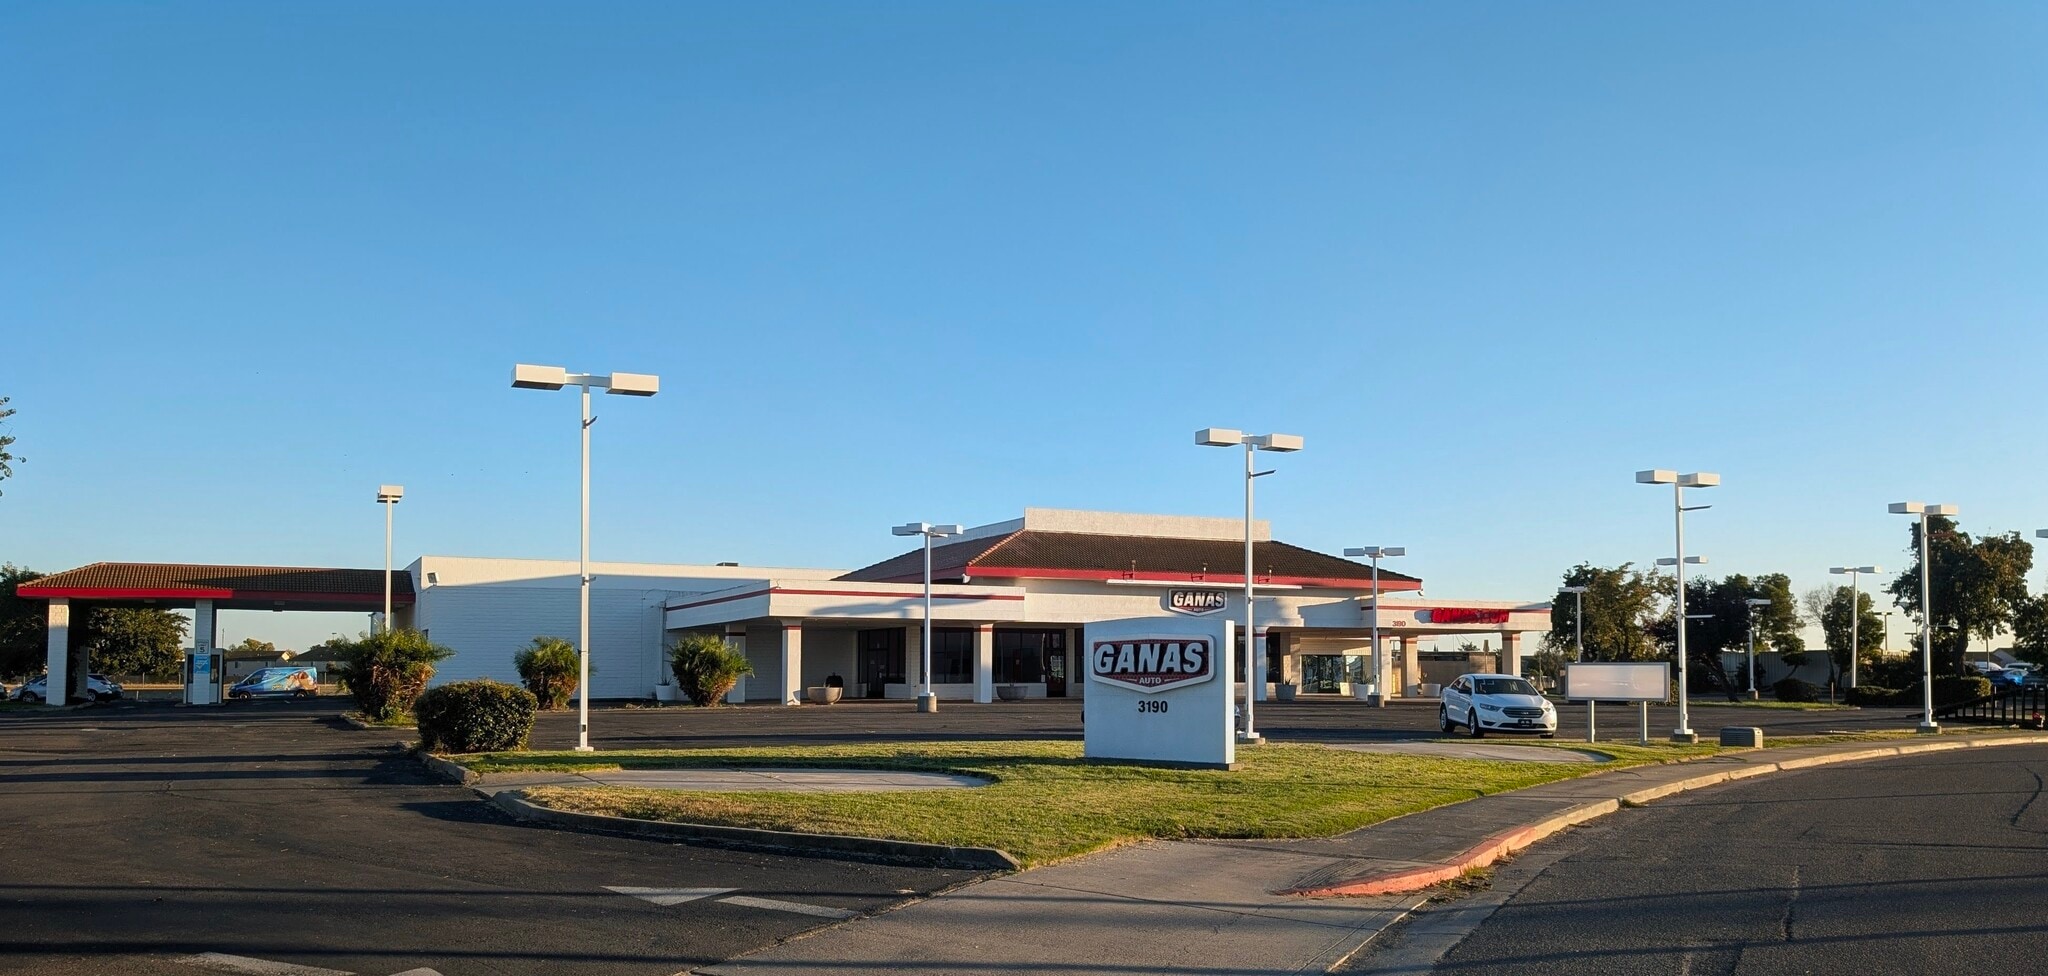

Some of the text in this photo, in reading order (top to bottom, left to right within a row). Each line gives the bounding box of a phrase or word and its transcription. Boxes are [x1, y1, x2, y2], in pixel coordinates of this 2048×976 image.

[1174, 592, 1224, 607] GANAS
[1094, 642, 1204, 673] GANAS
[1138, 701, 1168, 713] 3190
